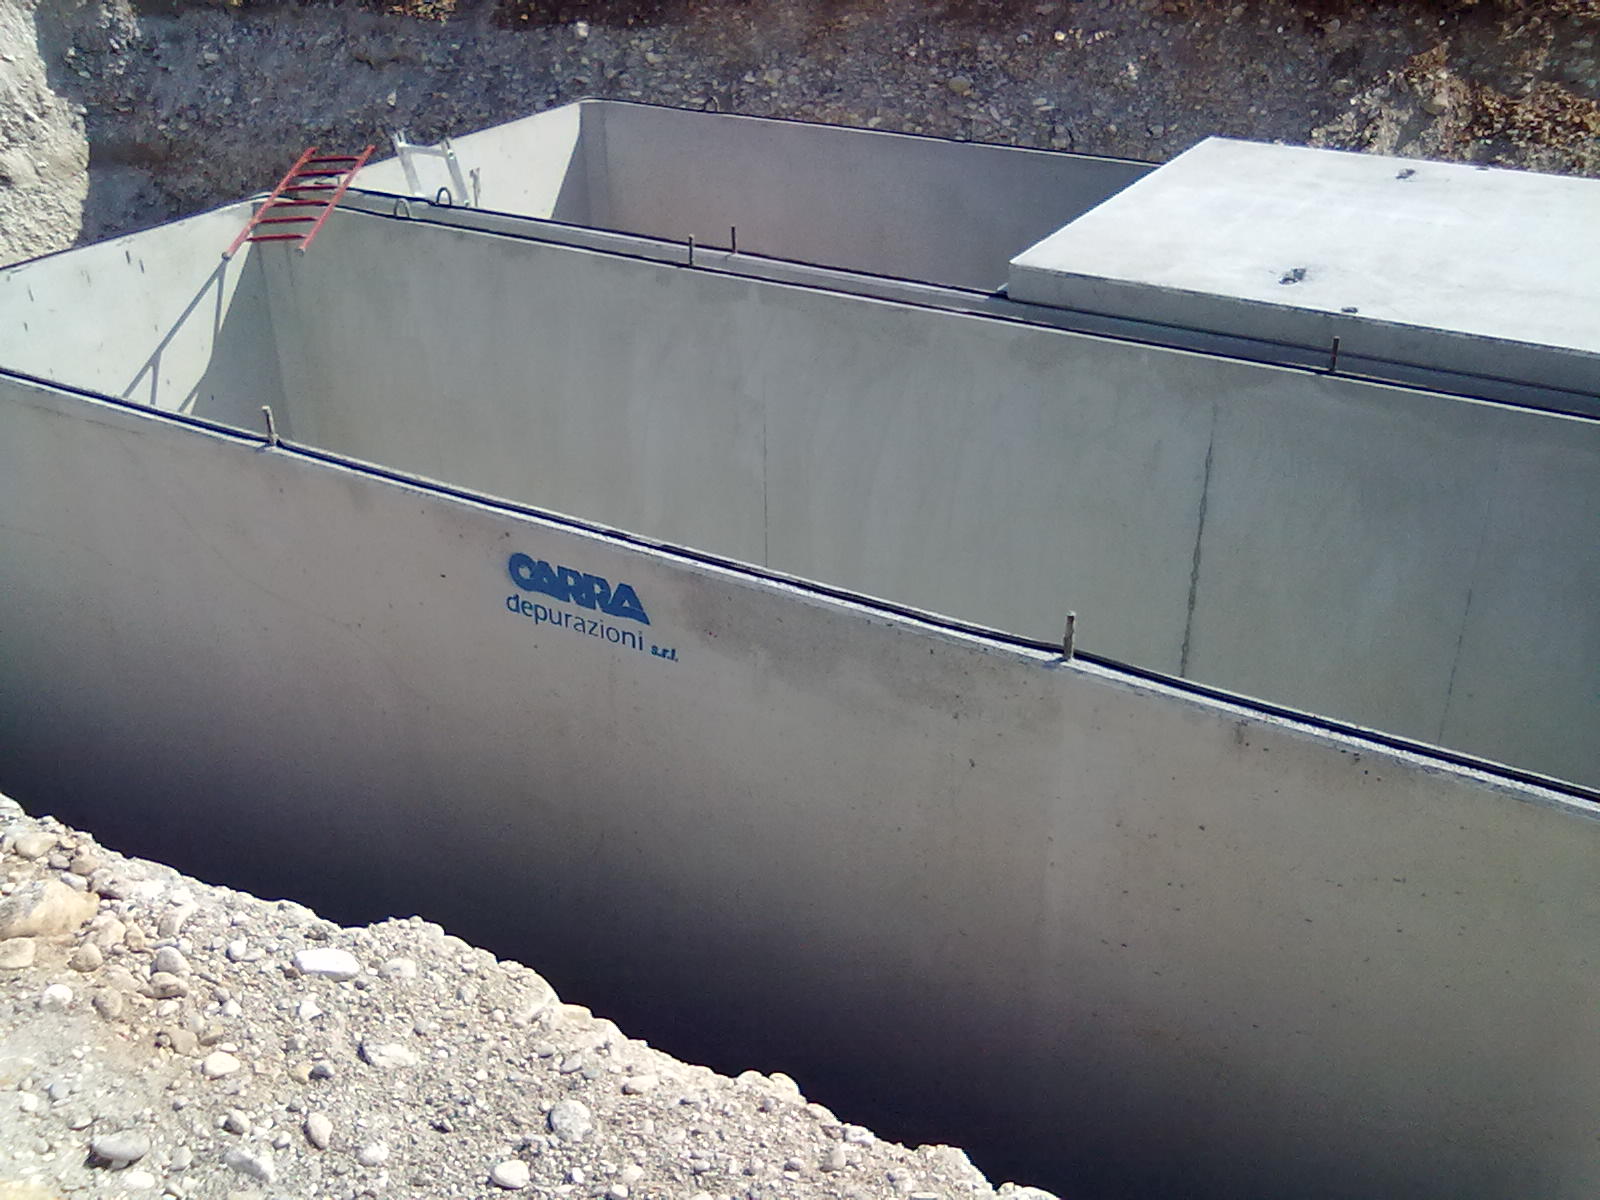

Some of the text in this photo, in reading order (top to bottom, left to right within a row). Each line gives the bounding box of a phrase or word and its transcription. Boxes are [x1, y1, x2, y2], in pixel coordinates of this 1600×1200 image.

[508, 553, 650, 625] CARRA
[506, 594, 679, 662] depurazioni s.r.l.
